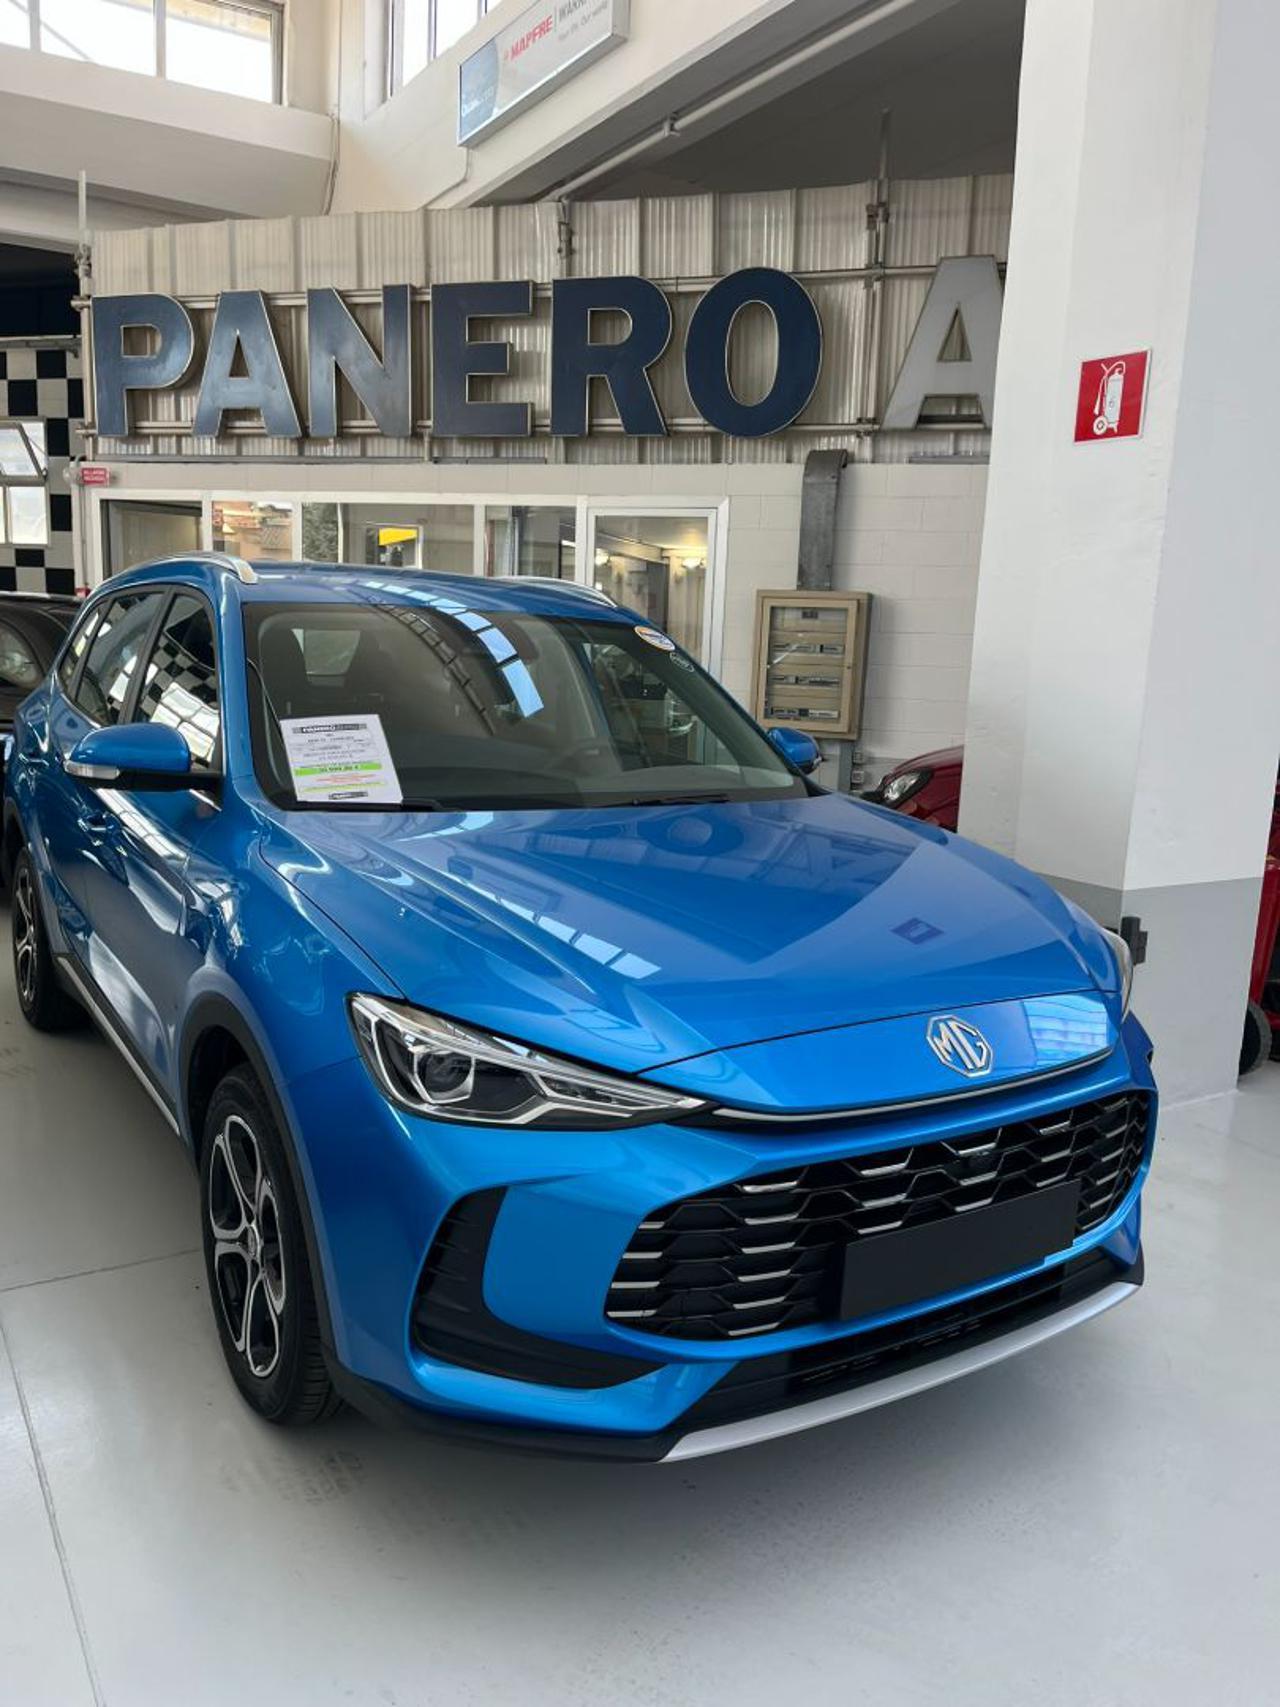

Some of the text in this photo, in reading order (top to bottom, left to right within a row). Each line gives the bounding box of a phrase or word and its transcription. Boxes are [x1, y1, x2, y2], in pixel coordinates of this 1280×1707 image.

[510, 15, 553, 61] MAPFRE
[92, 267, 823, 438] PANERO
[931, 1018, 989, 1073] MG
